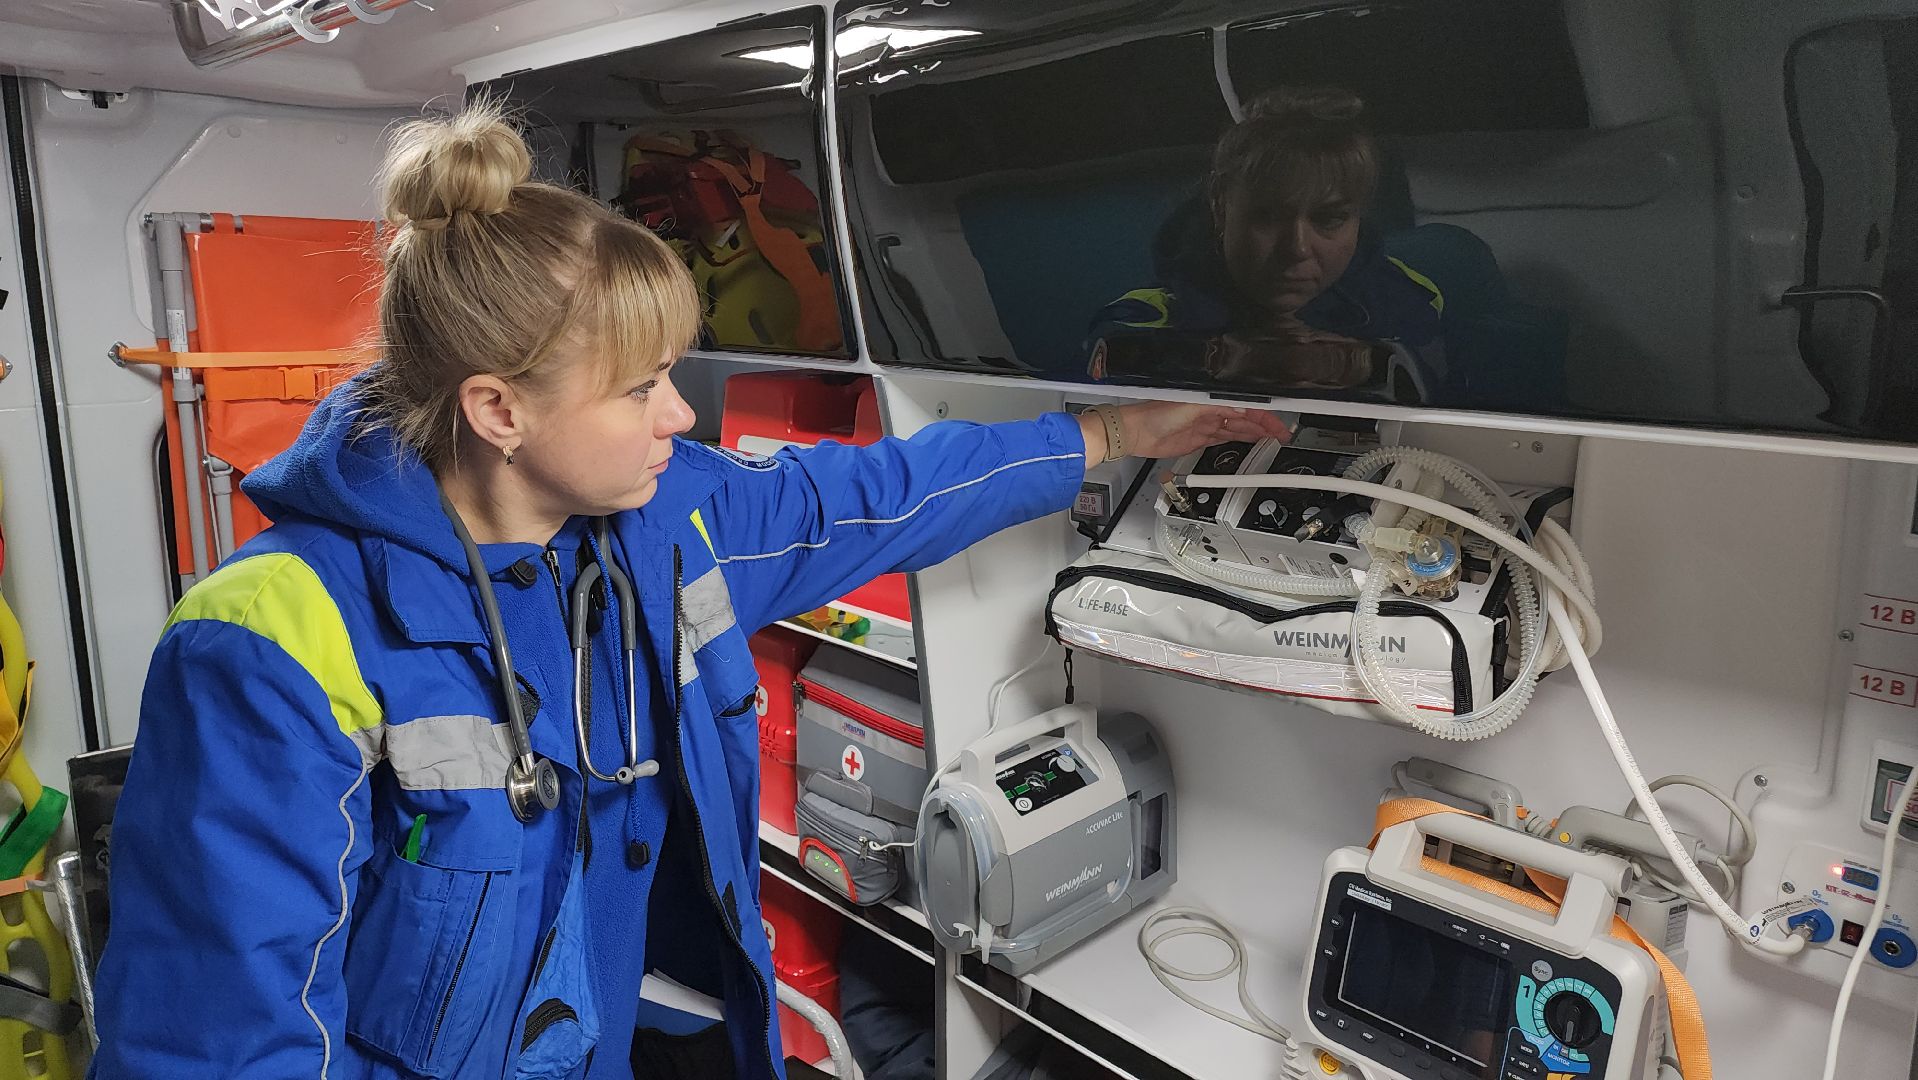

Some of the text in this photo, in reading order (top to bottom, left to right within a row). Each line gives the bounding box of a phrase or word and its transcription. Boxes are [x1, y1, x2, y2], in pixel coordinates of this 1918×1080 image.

[1078, 597, 1130, 617] LIFE-BASE
[1870, 604, 1916, 625] 12 В
[1860, 674, 1906, 696] 12 В
[1085, 815, 1113, 836] ACCUVAC
[1045, 864, 1103, 902] WEINMANN
[1534, 965, 1549, 976] Sync
[1522, 984, 1531, 999] 1
[1547, 1053, 1570, 1067] MONITOR
